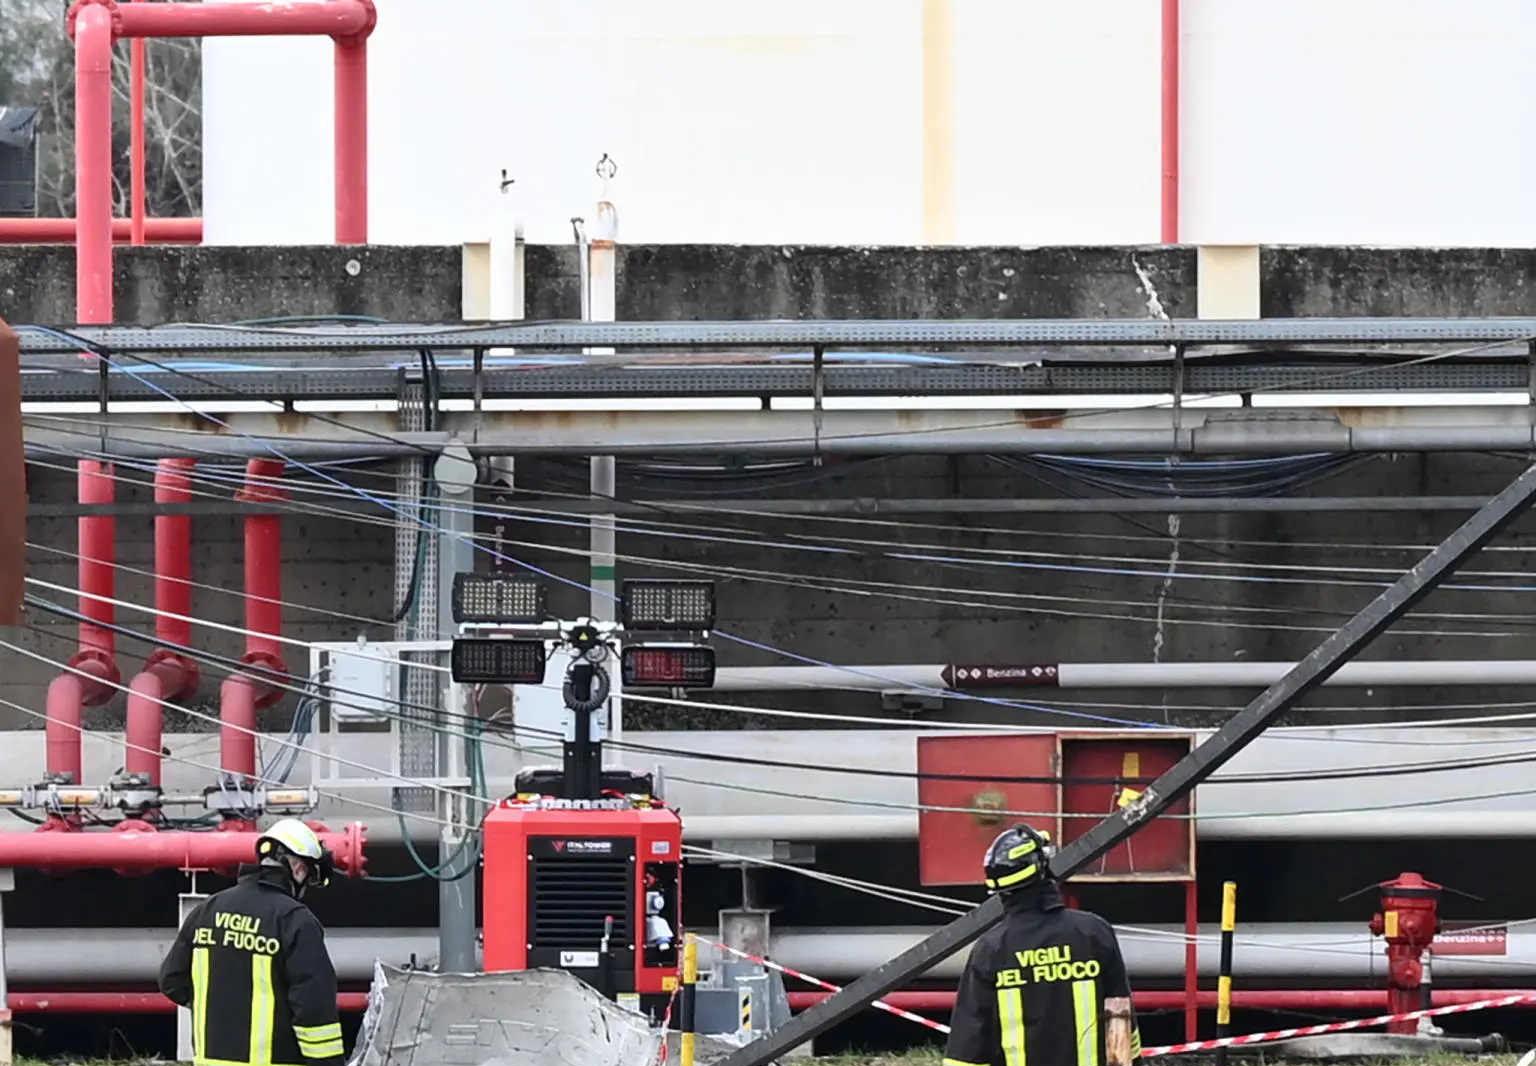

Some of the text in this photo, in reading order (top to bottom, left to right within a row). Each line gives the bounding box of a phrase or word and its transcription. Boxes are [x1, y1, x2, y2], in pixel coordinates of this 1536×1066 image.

[986, 668, 1027, 679] Benzina
[215, 912, 261, 934] VIGILI
[223, 930, 280, 955] FUOCO
[1433, 933, 1487, 944] Benzina
[1015, 945, 1071, 967] VIGILI
[1033, 959, 1100, 983] FUOCO
